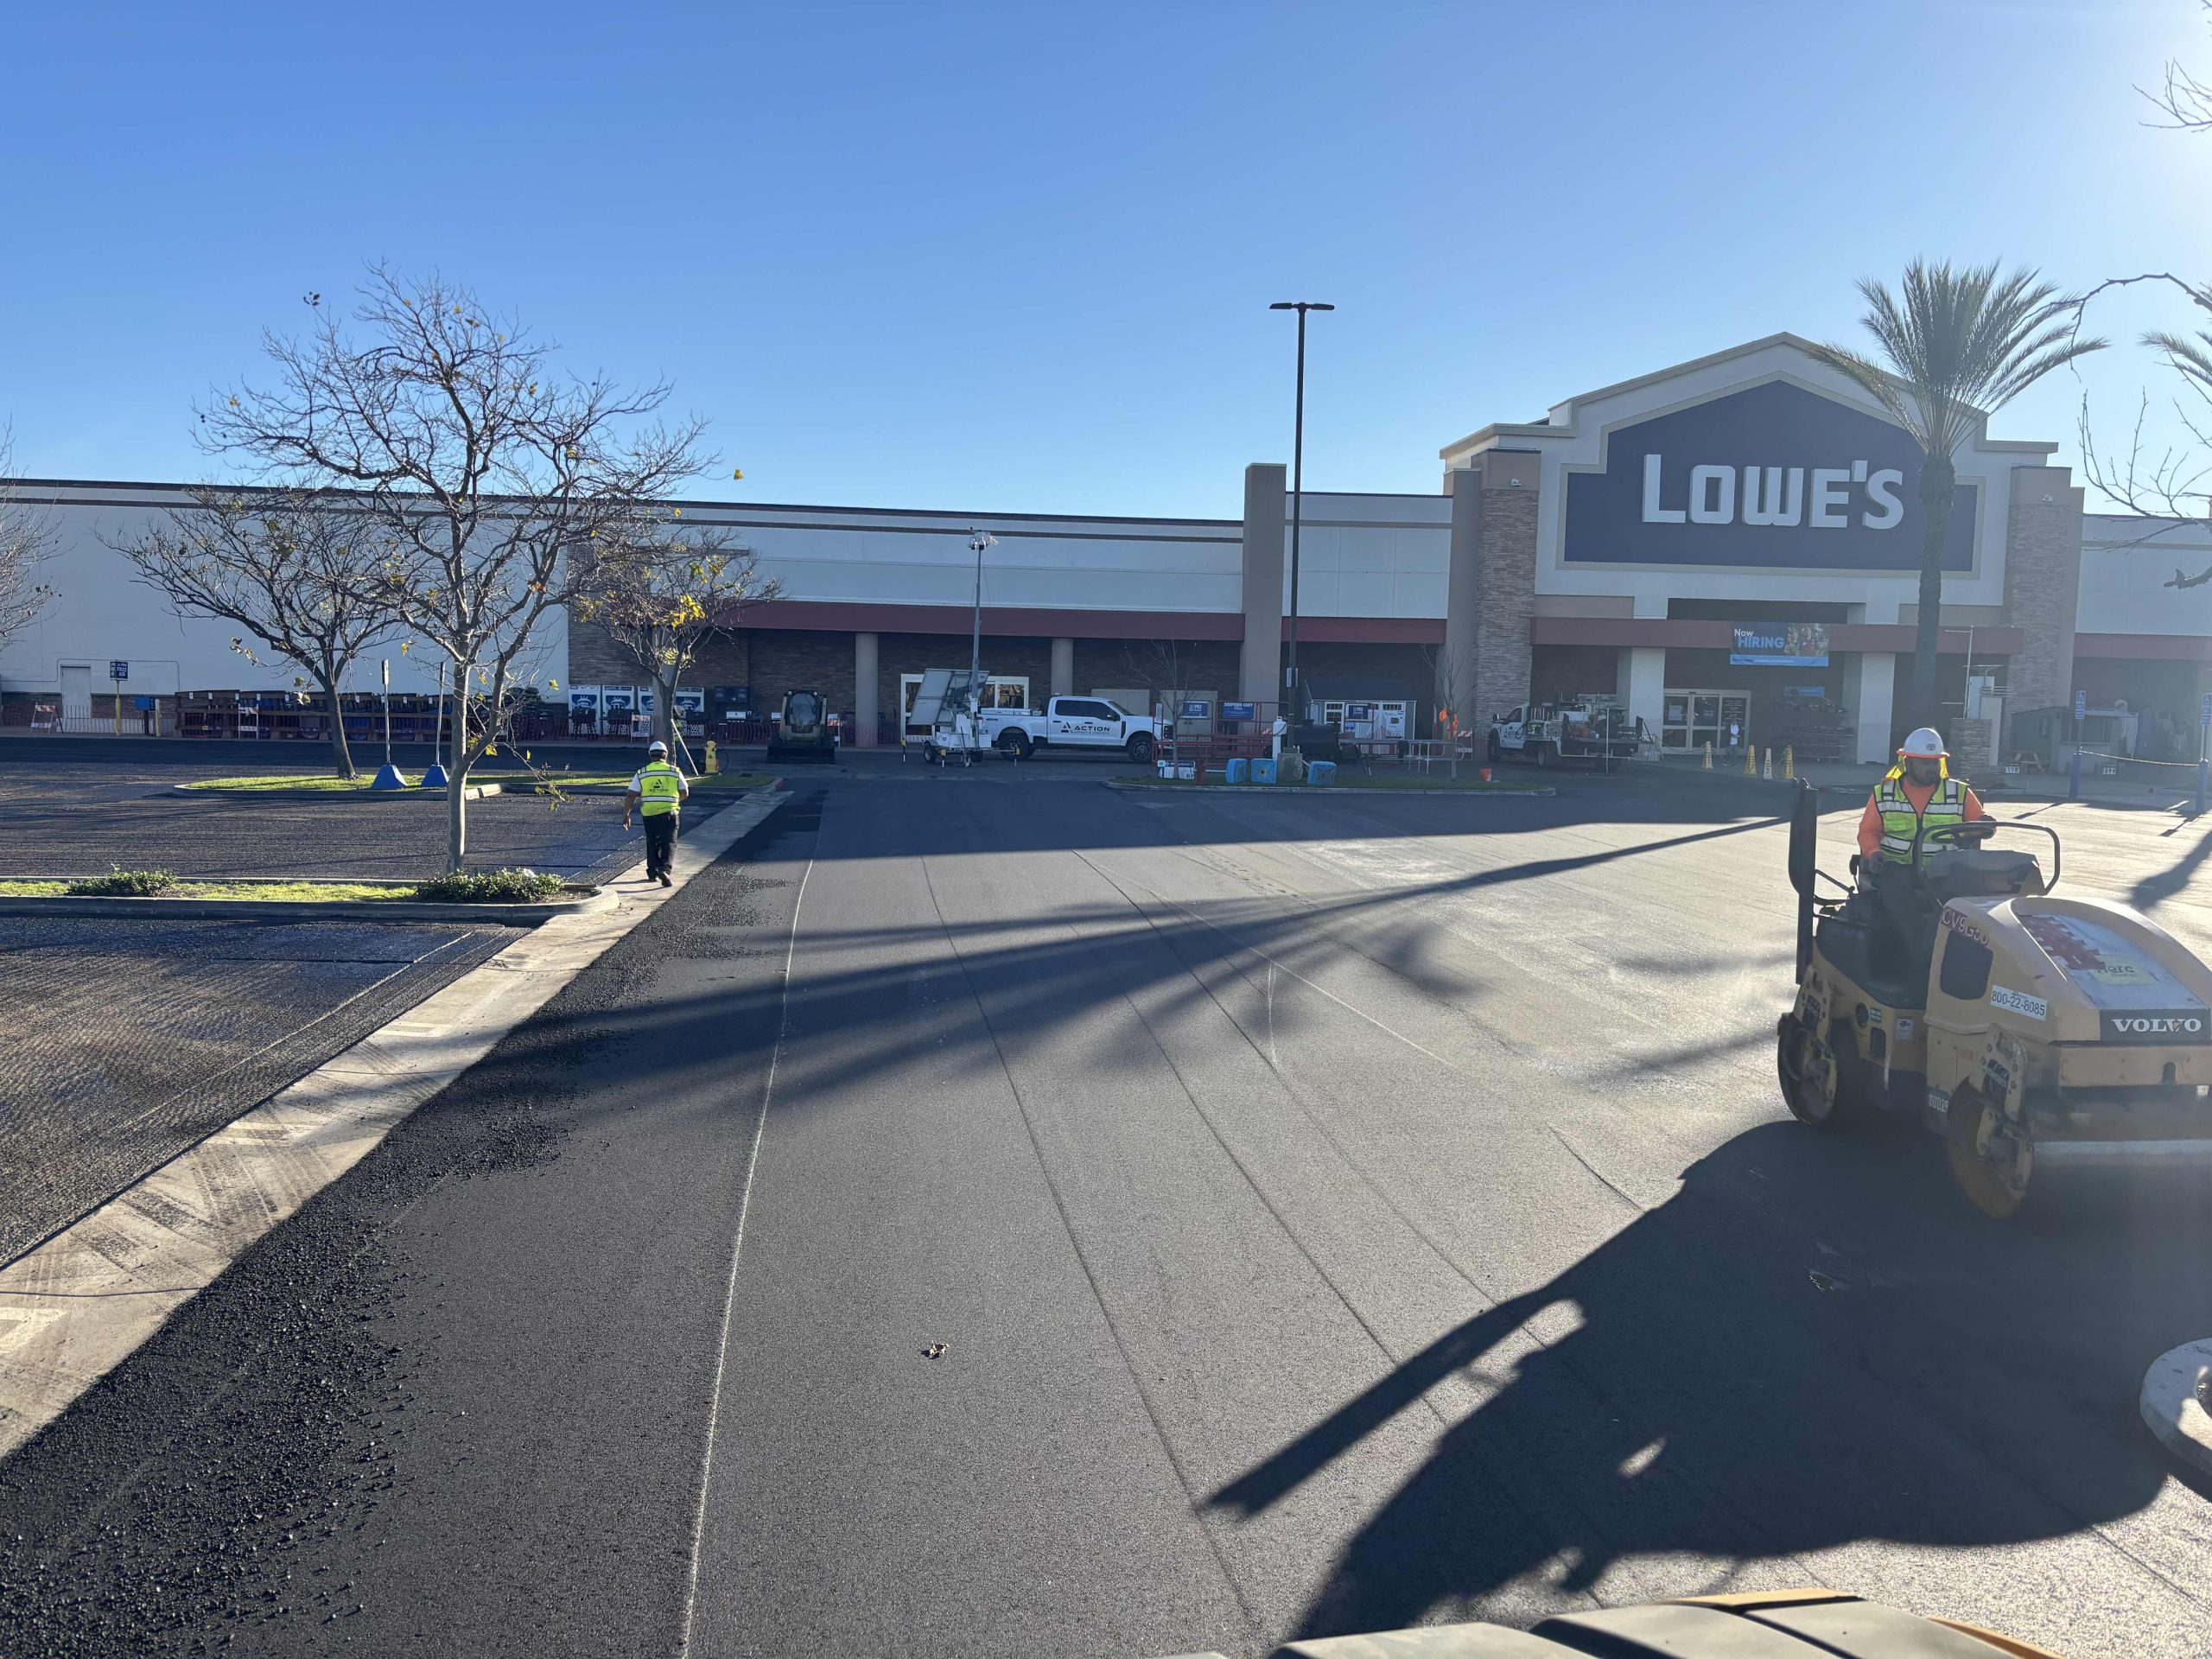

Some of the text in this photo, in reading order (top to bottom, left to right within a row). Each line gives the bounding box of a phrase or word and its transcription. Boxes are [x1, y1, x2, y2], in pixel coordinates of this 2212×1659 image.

[1642, 454, 1904, 530] LOWE'S
[1738, 636, 1785, 648] HIRING
[1992, 990, 2046, 1016] 800-22-8085
[2111, 1018, 2202, 1033] VOLVO
